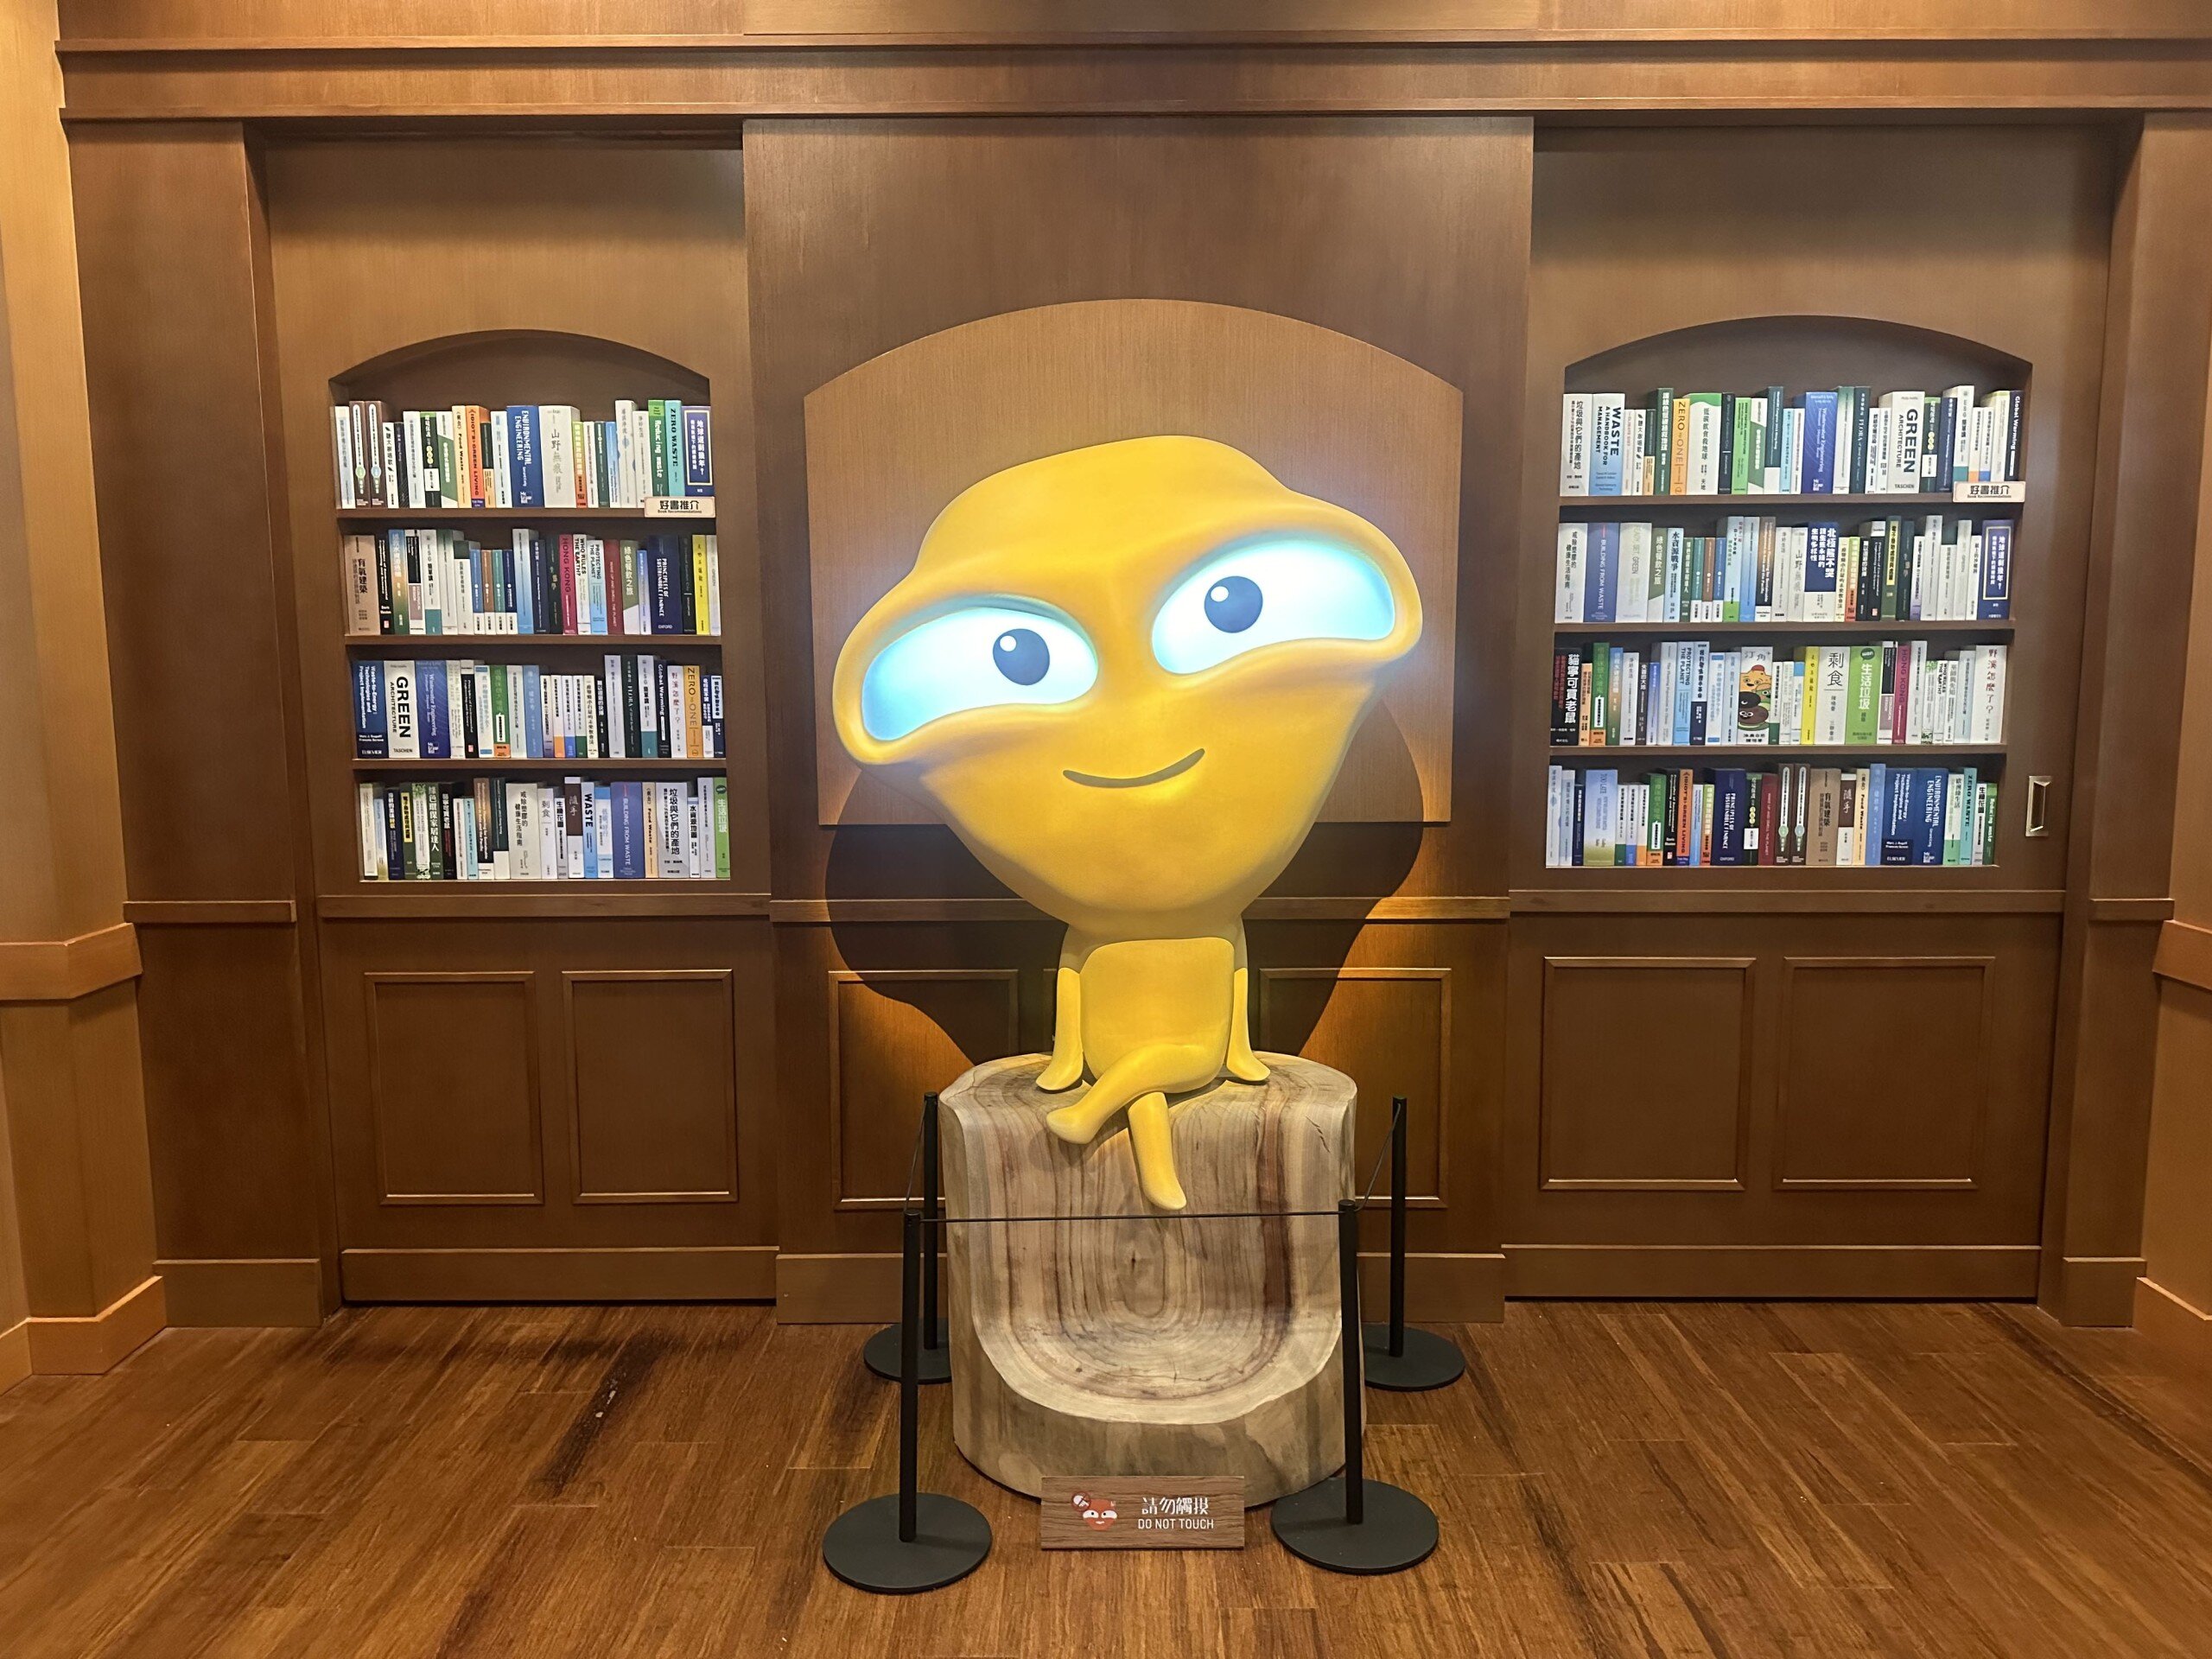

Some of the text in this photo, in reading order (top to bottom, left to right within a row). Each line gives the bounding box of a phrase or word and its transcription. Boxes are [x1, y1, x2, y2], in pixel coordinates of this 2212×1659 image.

[515, 416, 524, 461] ENGINEERING
[521, 410, 531, 465] ENVIRONMENTAL
[654, 420, 663, 454] Reducing
[1611, 407, 1621, 455] WASTE
[1904, 409, 1918, 473] GREEN
[659, 500, 699, 510] 好書推介
[1970, 485, 2009, 494] 好書推介
[1827, 652, 1844, 686] 剩食
[1859, 664, 1872, 709] 生活垃圾
[397, 677, 410, 738] GREEN
[542, 800, 551, 817] 剩食
[670, 788, 680, 855] 垃圾與它們的產地
[718, 798, 728, 833] 生活垃圾
[1925, 780, 1935, 823] ENGINEERING
[1932, 775, 1942, 828] ENVIRONMENTAL
[1138, 1519, 1214, 1529] DO NOT TOUCH
[1141, 1497, 1209, 1515] 請勿觸摸
